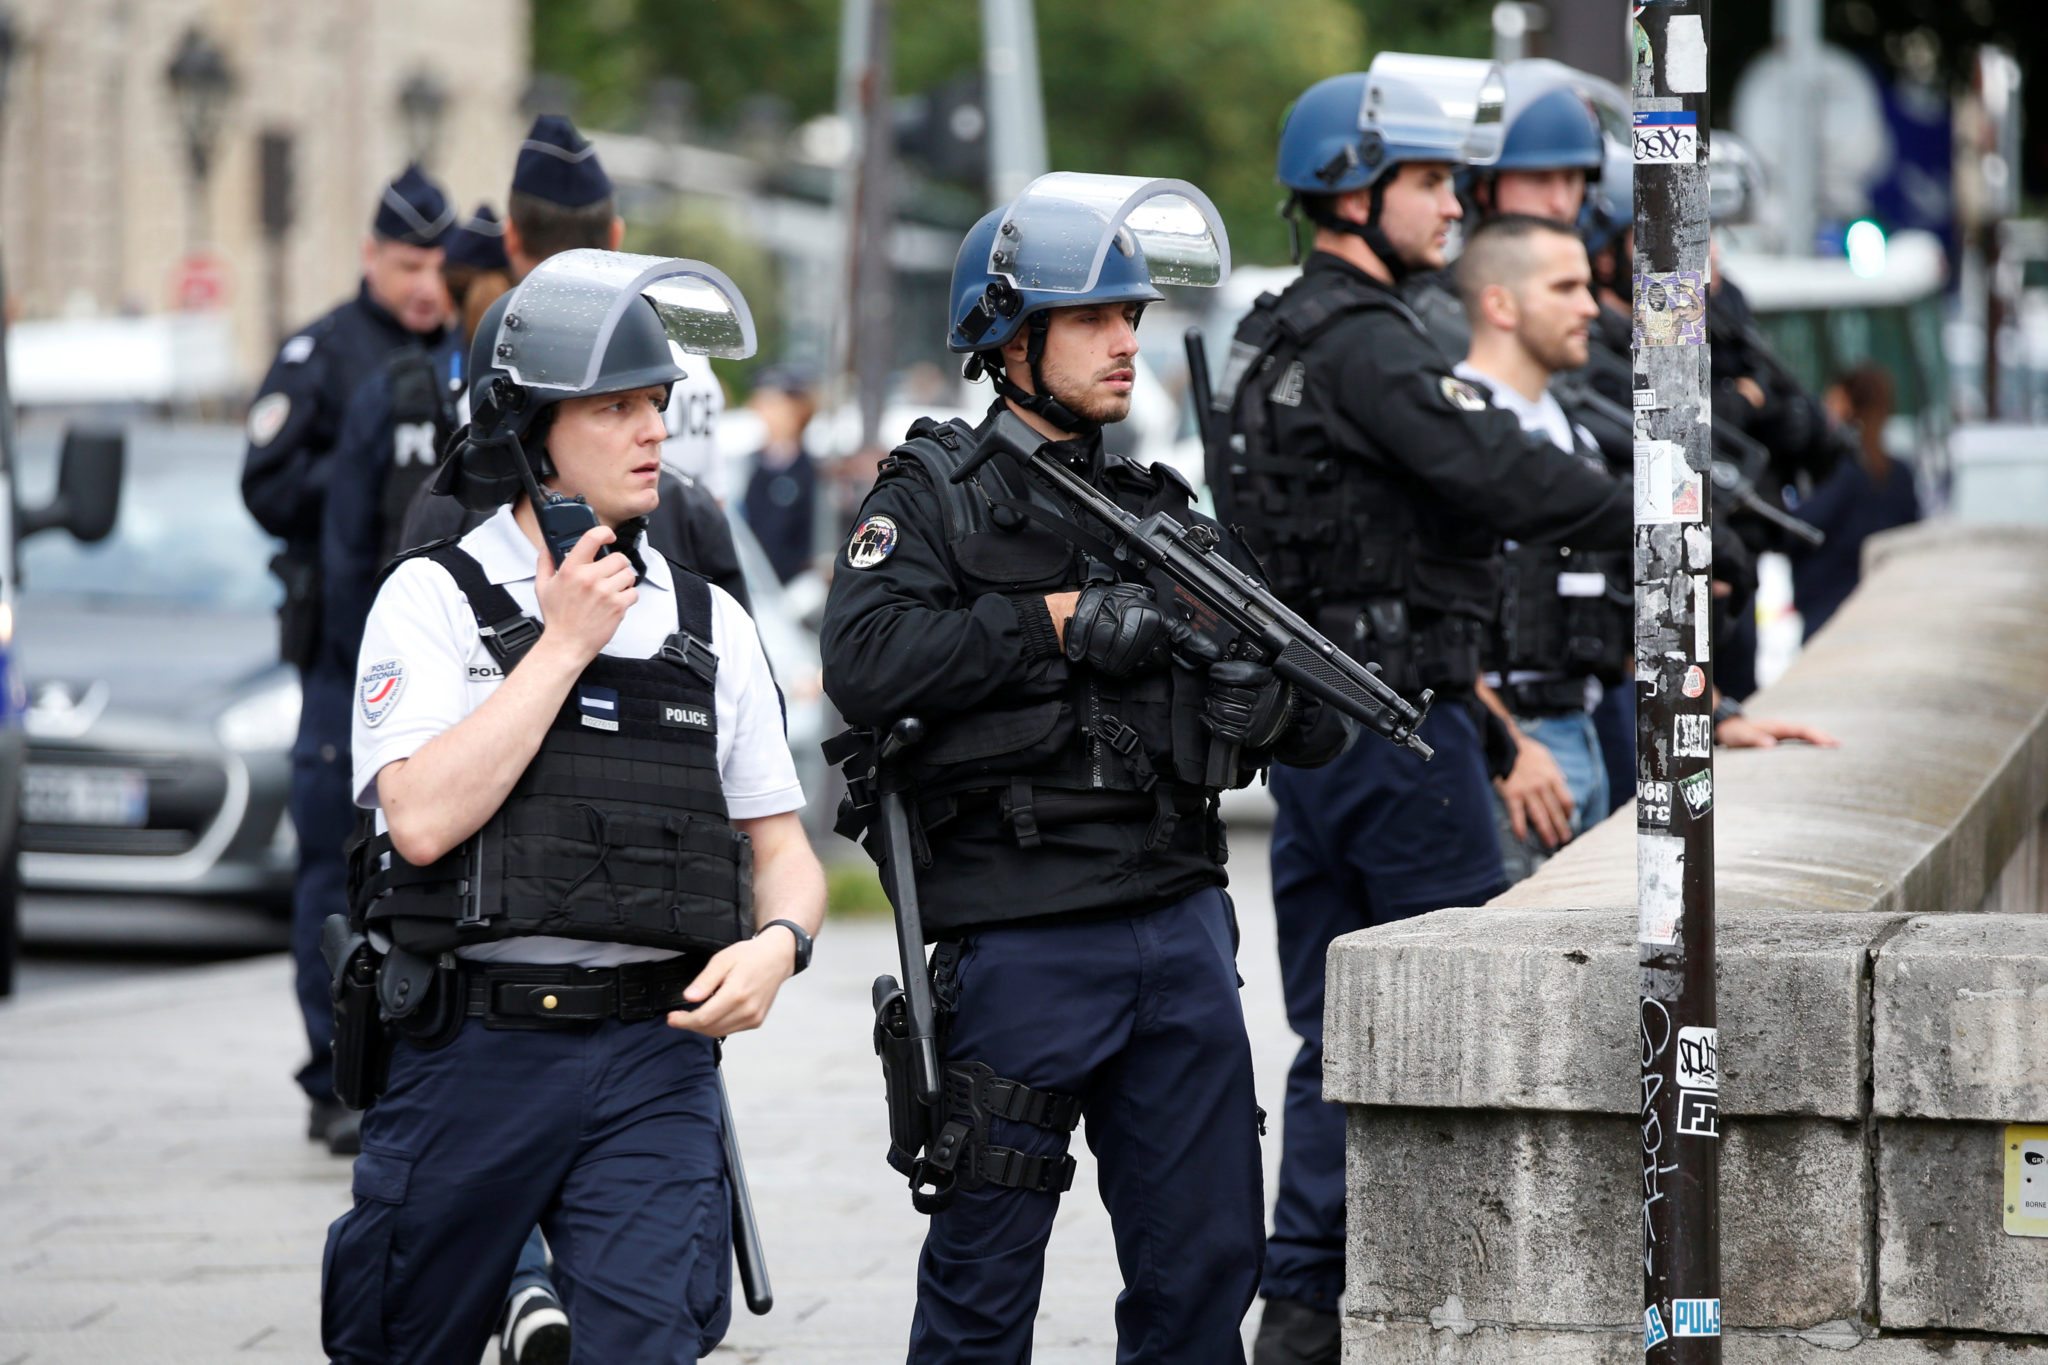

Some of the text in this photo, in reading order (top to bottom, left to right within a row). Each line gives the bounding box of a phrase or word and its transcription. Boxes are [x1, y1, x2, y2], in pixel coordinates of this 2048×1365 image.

[371, 661, 397, 672] POLICE
[469, 667, 505, 677] POL
[363, 668, 403, 682] NATIONALE
[665, 707, 708, 726] POLICE
[1675, 1301, 1720, 1333] PULS
